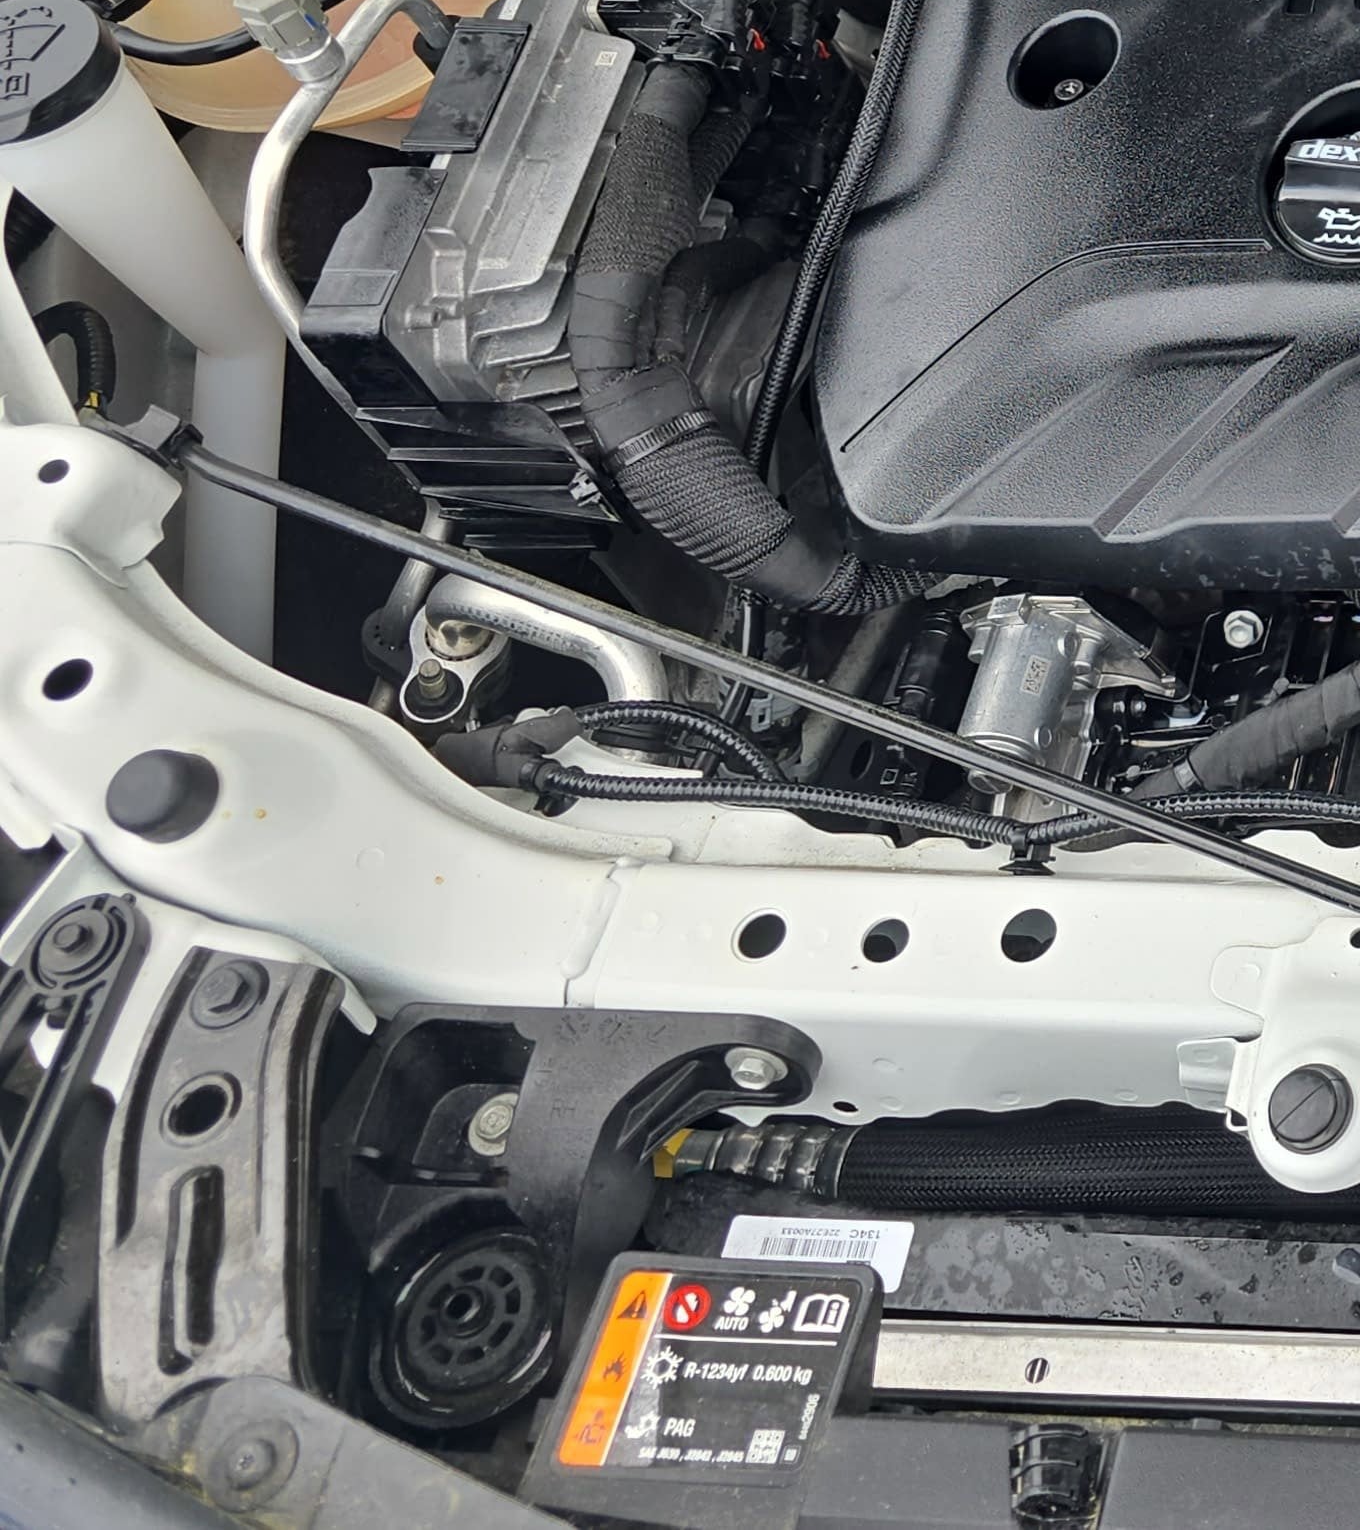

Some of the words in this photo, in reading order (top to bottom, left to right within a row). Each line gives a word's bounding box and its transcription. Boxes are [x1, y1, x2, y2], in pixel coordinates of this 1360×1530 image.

[714, 1316, 749, 1331] AUTO
[683, 1361, 749, 1384] R-1234yf
[752, 1364, 792, 1382] 0.600
[793, 1367, 813, 1385] kg
[664, 1418, 696, 1437] PAG
